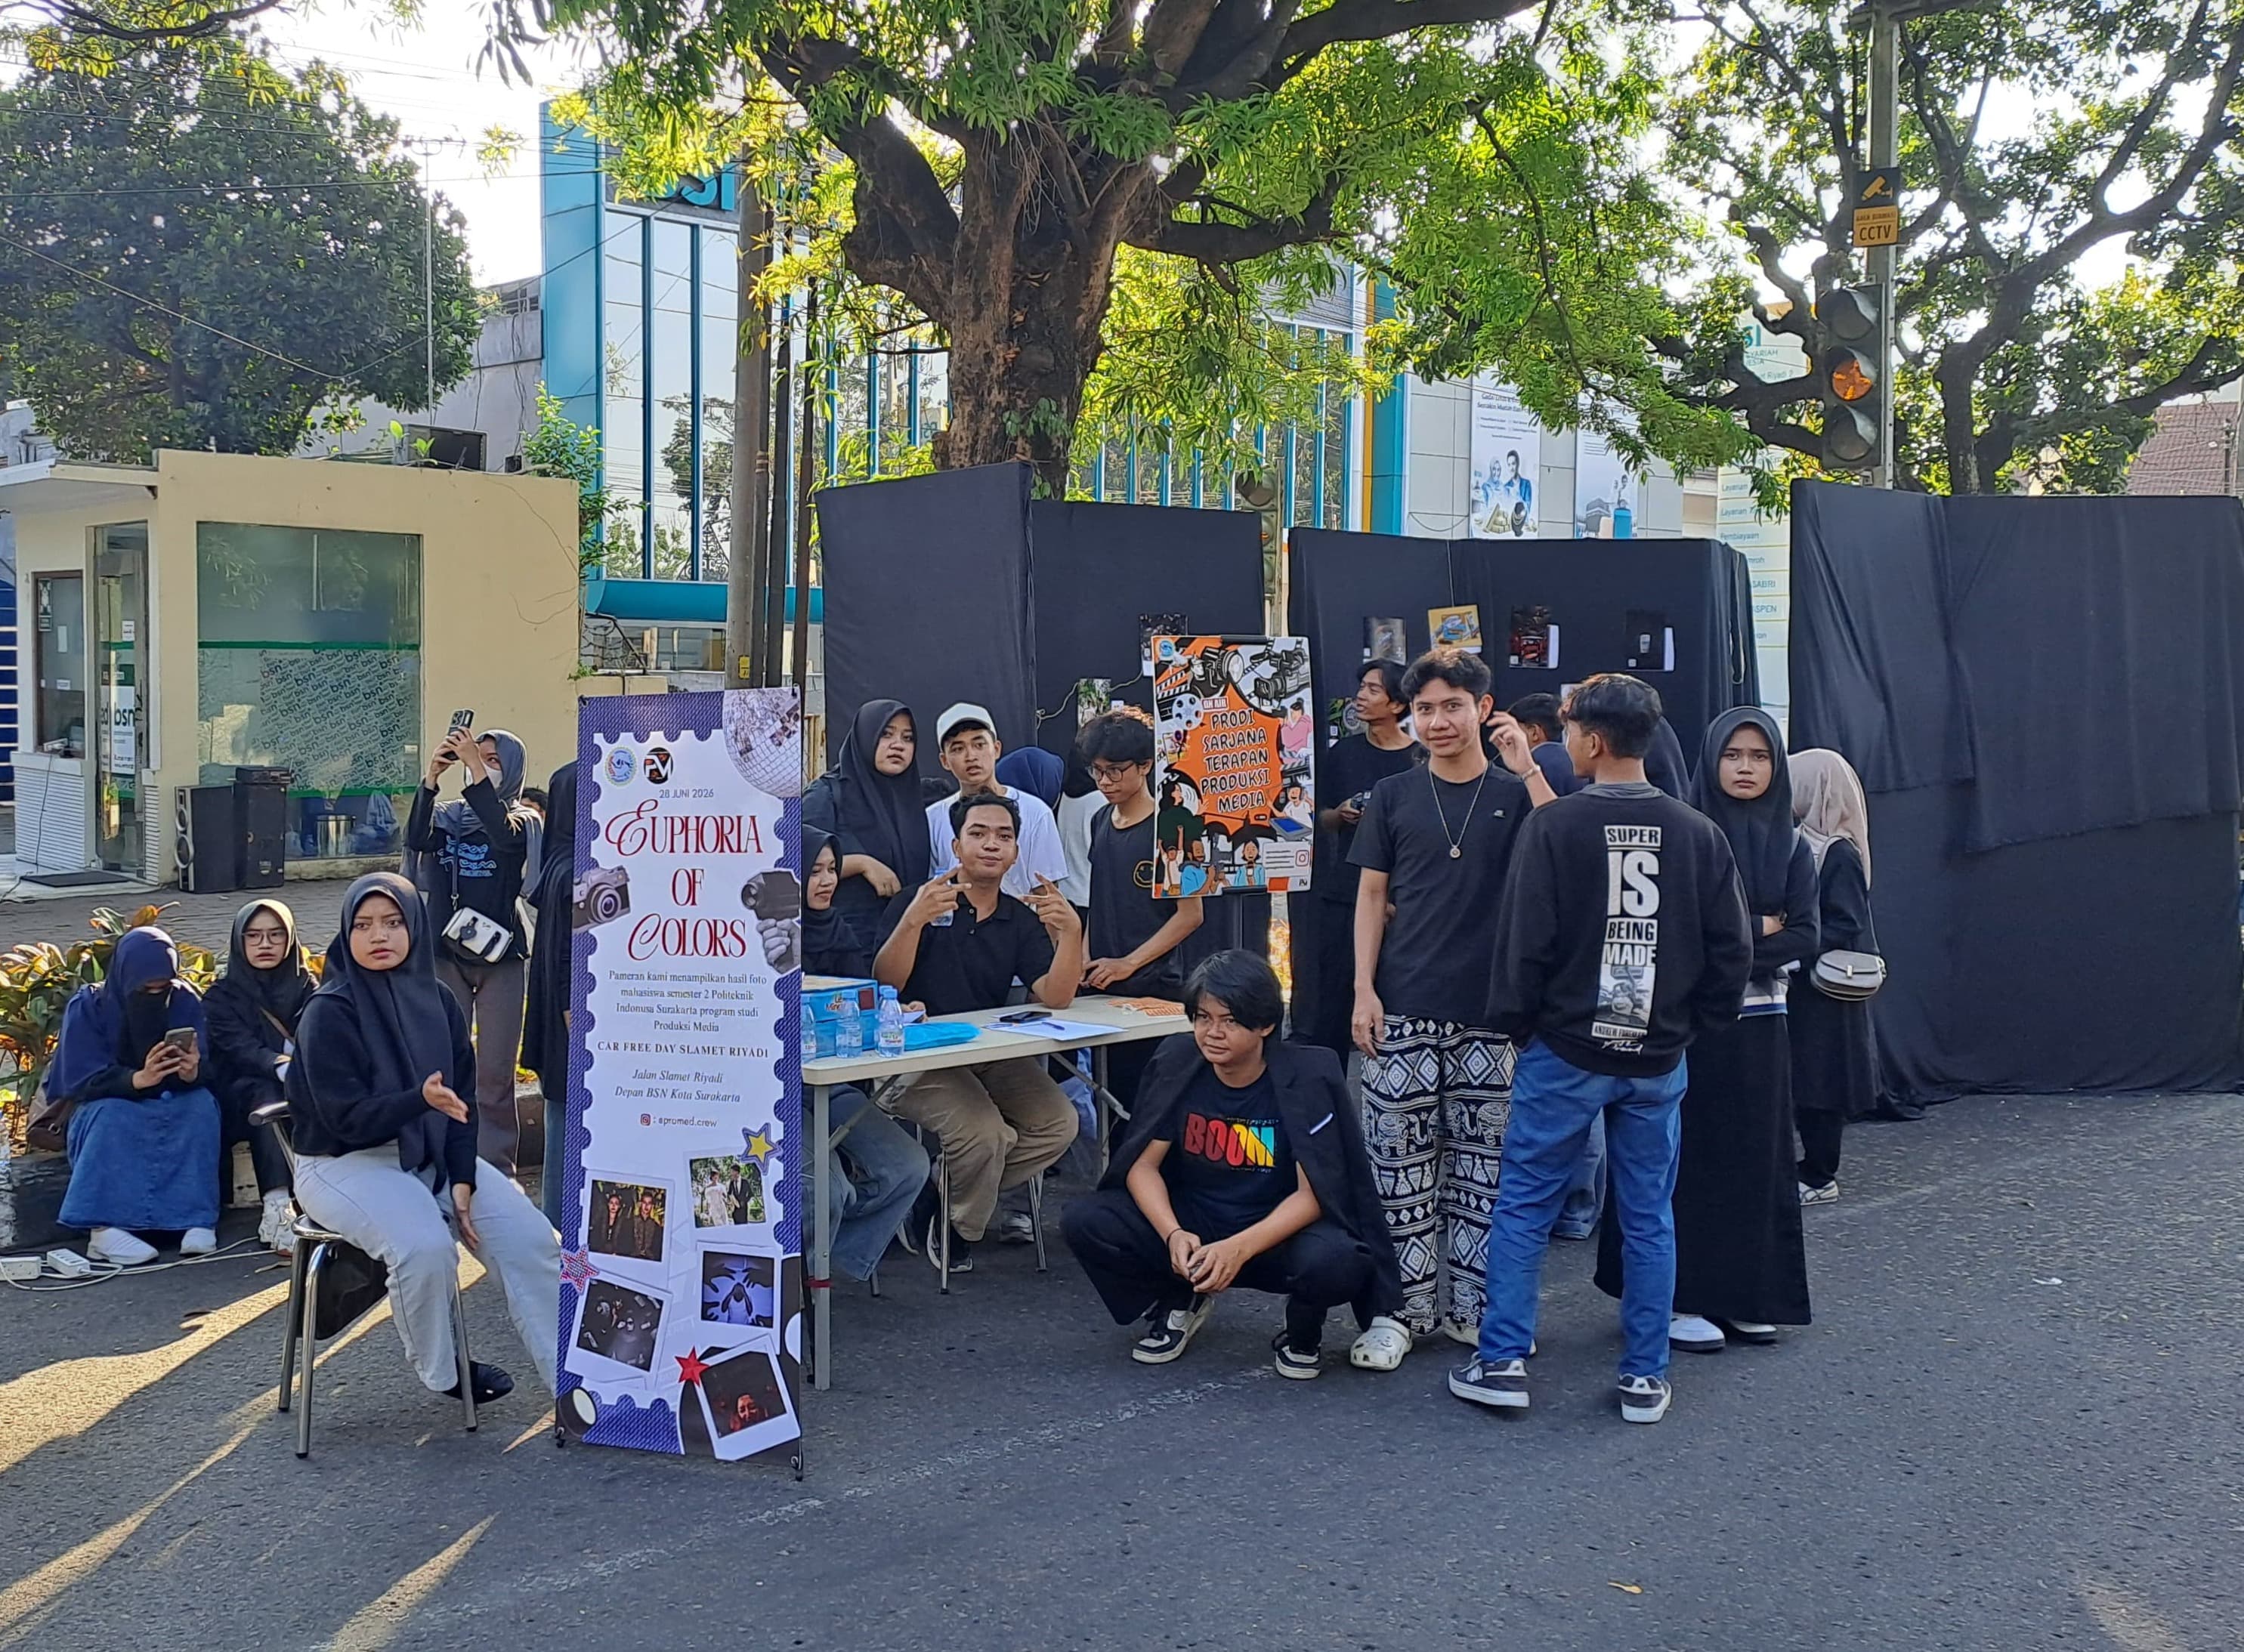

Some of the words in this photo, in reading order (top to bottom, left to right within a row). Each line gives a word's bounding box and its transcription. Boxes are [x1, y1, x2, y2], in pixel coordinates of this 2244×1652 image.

[1859, 225, 1892, 240] CCTV
[379, 656, 400, 669] bsn
[260, 665, 283, 678] bsn
[294, 672, 316, 687] bsn
[329, 678, 351, 693] bsn
[363, 686, 383, 700] bsn
[113, 702, 135, 727] bsn
[279, 702, 301, 717] bsn
[312, 711, 333, 724] bsn
[348, 717, 369, 730] bsn
[1211, 709, 1254, 730] PRODI
[380, 724, 400, 738] bsn
[1202, 727, 1267, 752] SARJANA
[298, 741, 319, 755] bsn
[365, 754, 386, 768] bsn
[1204, 748, 1269, 773] TERAPAN
[1201, 768, 1271, 794] PRODUKSI
[672, 789, 690, 798] JUNI
[691, 788, 714, 798] 2026
[1218, 791, 1266, 814] MEDIA
[605, 798, 763, 857] EUPHORIA
[1607, 828, 1659, 845] SUPER
[672, 868, 704, 906] OF
[1607, 851, 1660, 917] IS
[628, 912, 746, 962] COLORS
[1607, 921, 1655, 942] BEING
[1603, 943, 1656, 966] MADE
[609, 970, 644, 980] Pameran
[648, 971, 668, 981] kami
[670, 972, 725, 985] menampilkan
[728, 973, 747, 983] hasil
[750, 974, 767, 984] foto
[620, 987, 665, 997] mahasiswa
[667, 990, 702, 999] semester
[704, 989, 709, 999] 2
[712, 990, 754, 1001] Politeknik
[617, 1002, 654, 1014] Indonusa
[657, 1003, 697, 1014] Surakarta
[700, 1008, 735, 1018] program
[737, 1007, 759, 1017] studi
[654, 1020, 691, 1031] Produksi
[693, 1021, 719, 1032] Media
[598, 1041, 619, 1051] CAR
[623, 1042, 651, 1052] FREE
[655, 1043, 676, 1054] DAY
[679, 1045, 725, 1055] SLAMET
[729, 1046, 768, 1058] RIYADI
[632, 1069, 657, 1079] Jalan
[659, 1070, 690, 1082] Slamet
[694, 1071, 723, 1084] Riyadi
[615, 1085, 643, 1098] Depan
[646, 1087, 668, 1098] BSN
[670, 1088, 692, 1100] Kota
[694, 1090, 740, 1103] Surakarta
